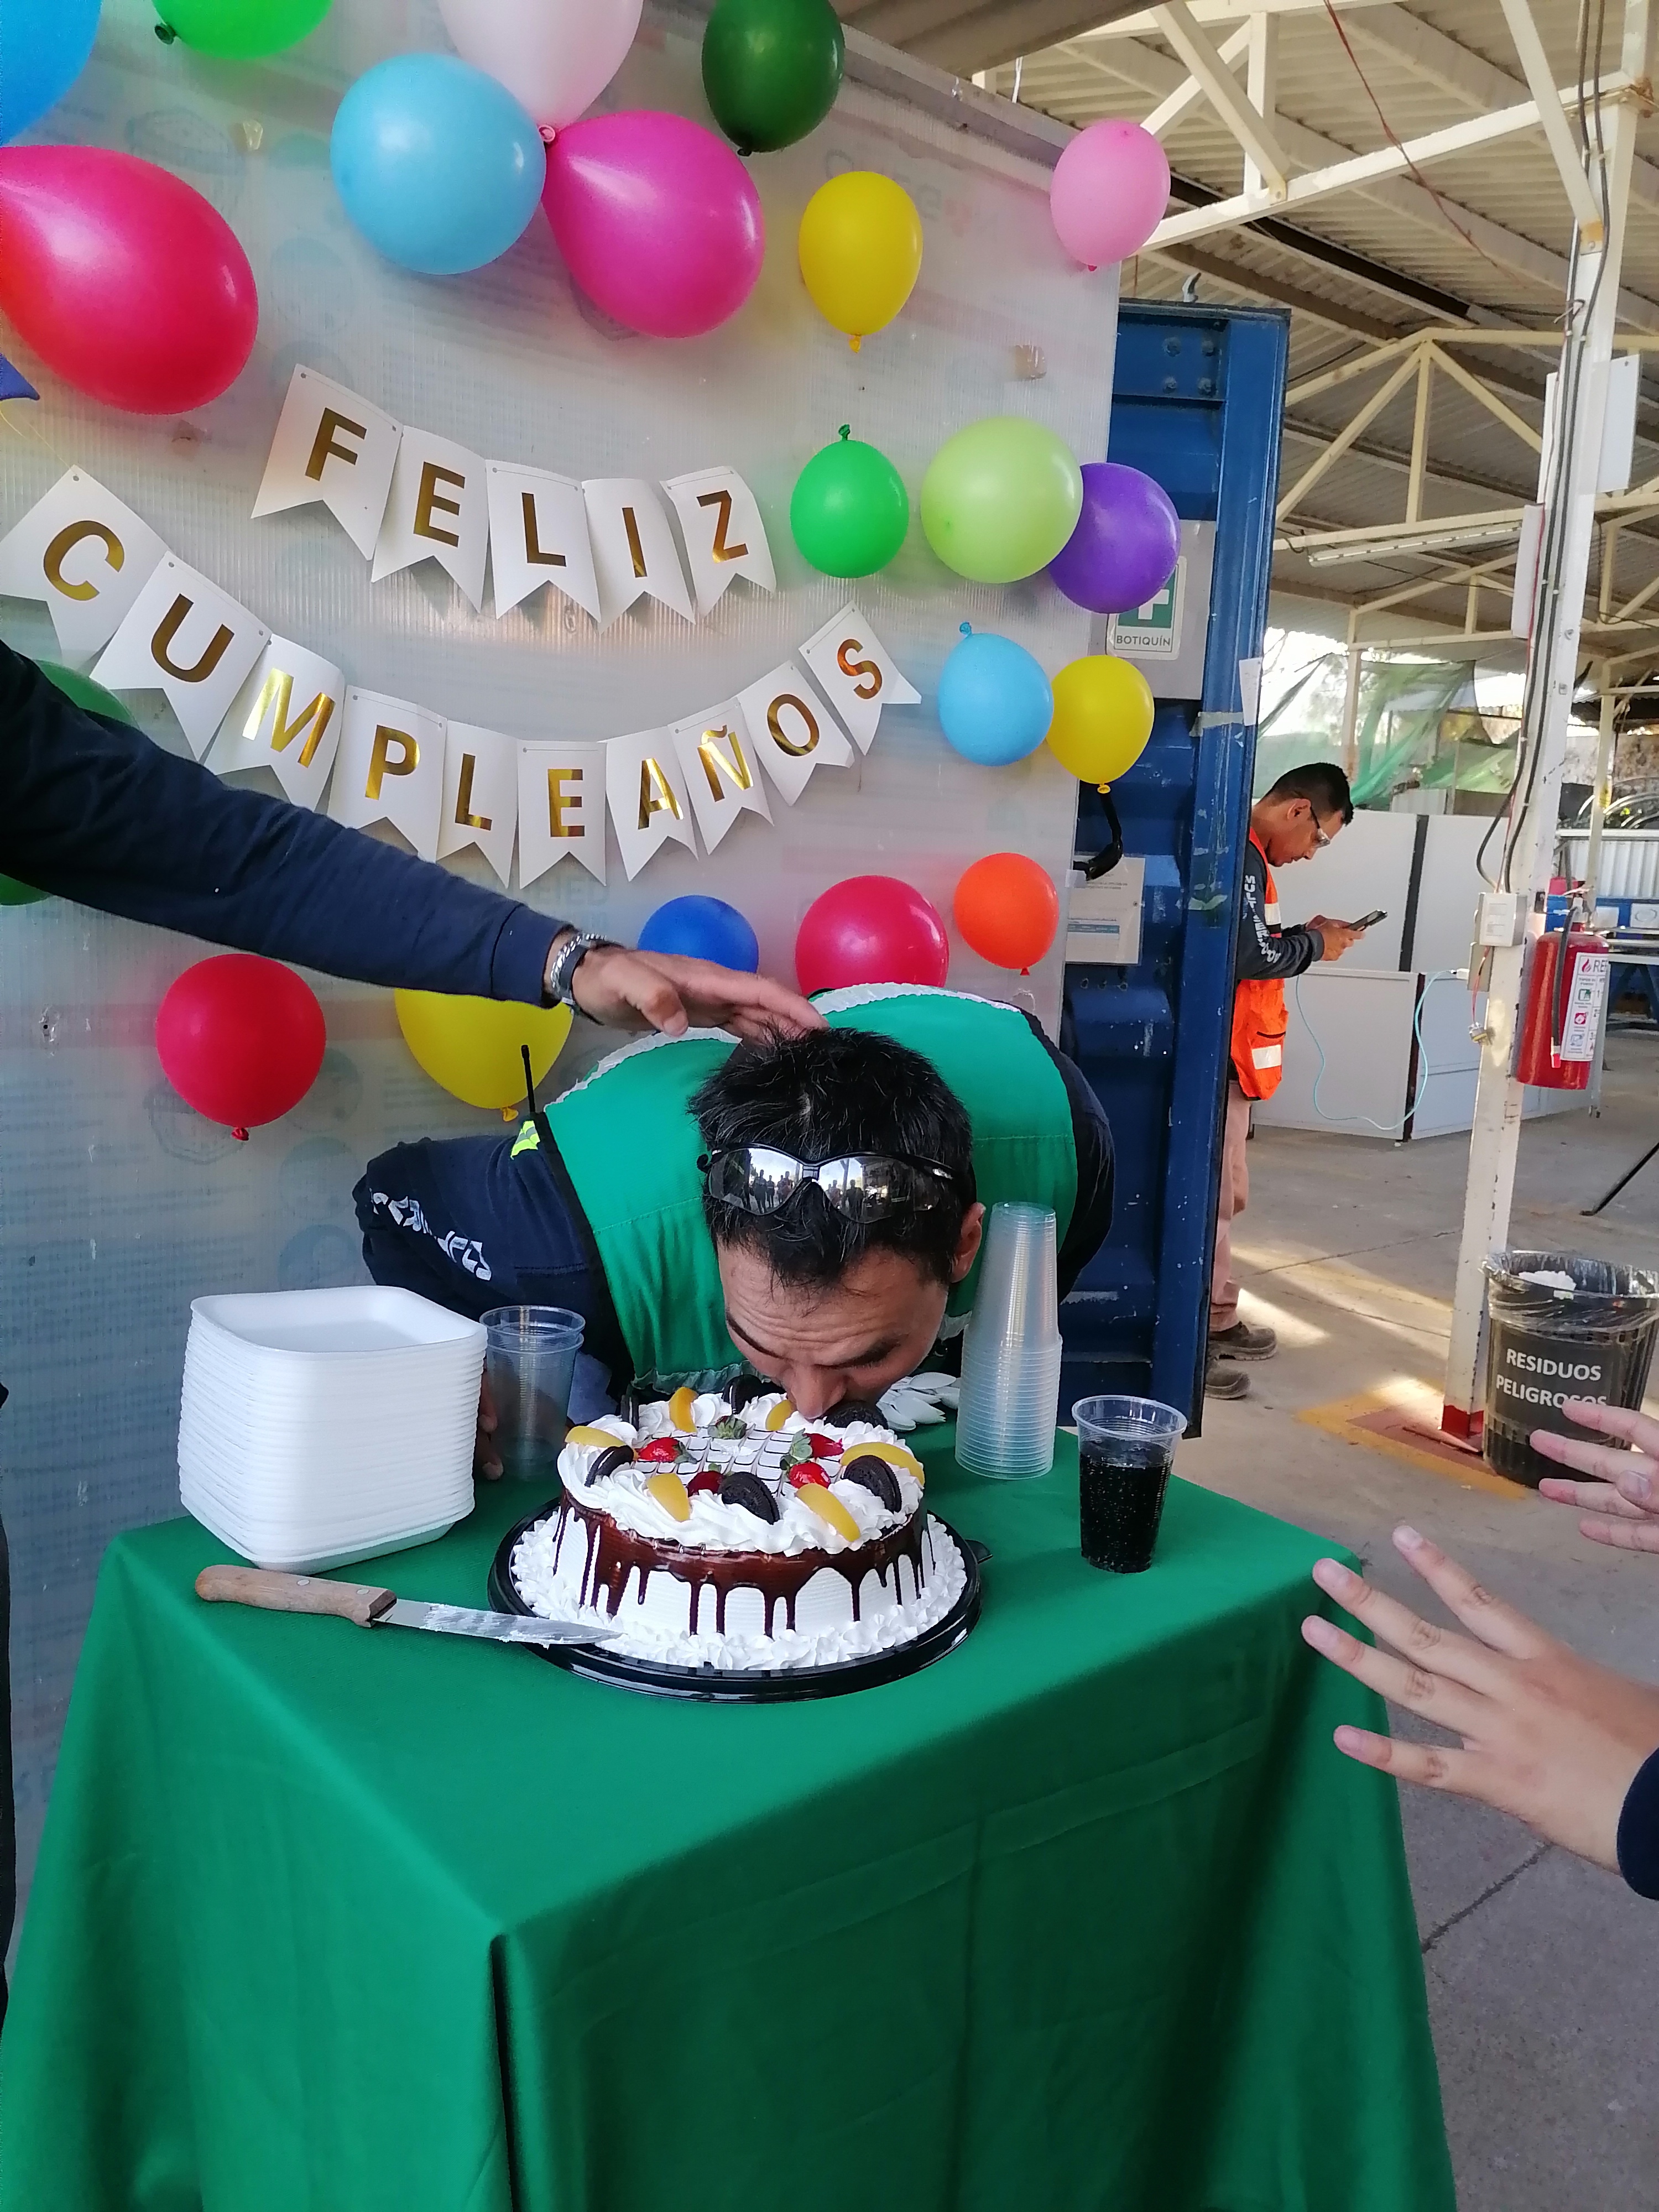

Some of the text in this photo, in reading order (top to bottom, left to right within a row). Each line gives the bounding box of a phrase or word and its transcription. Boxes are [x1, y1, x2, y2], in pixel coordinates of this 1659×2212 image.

[305, 408, 749, 578] FELIZ
[43, 520, 883, 838] CUMPLEAÑOS
[1116, 635, 1171, 646] BOTIQUÍN
[1506, 1348, 1601, 1381] RESIDUOS
